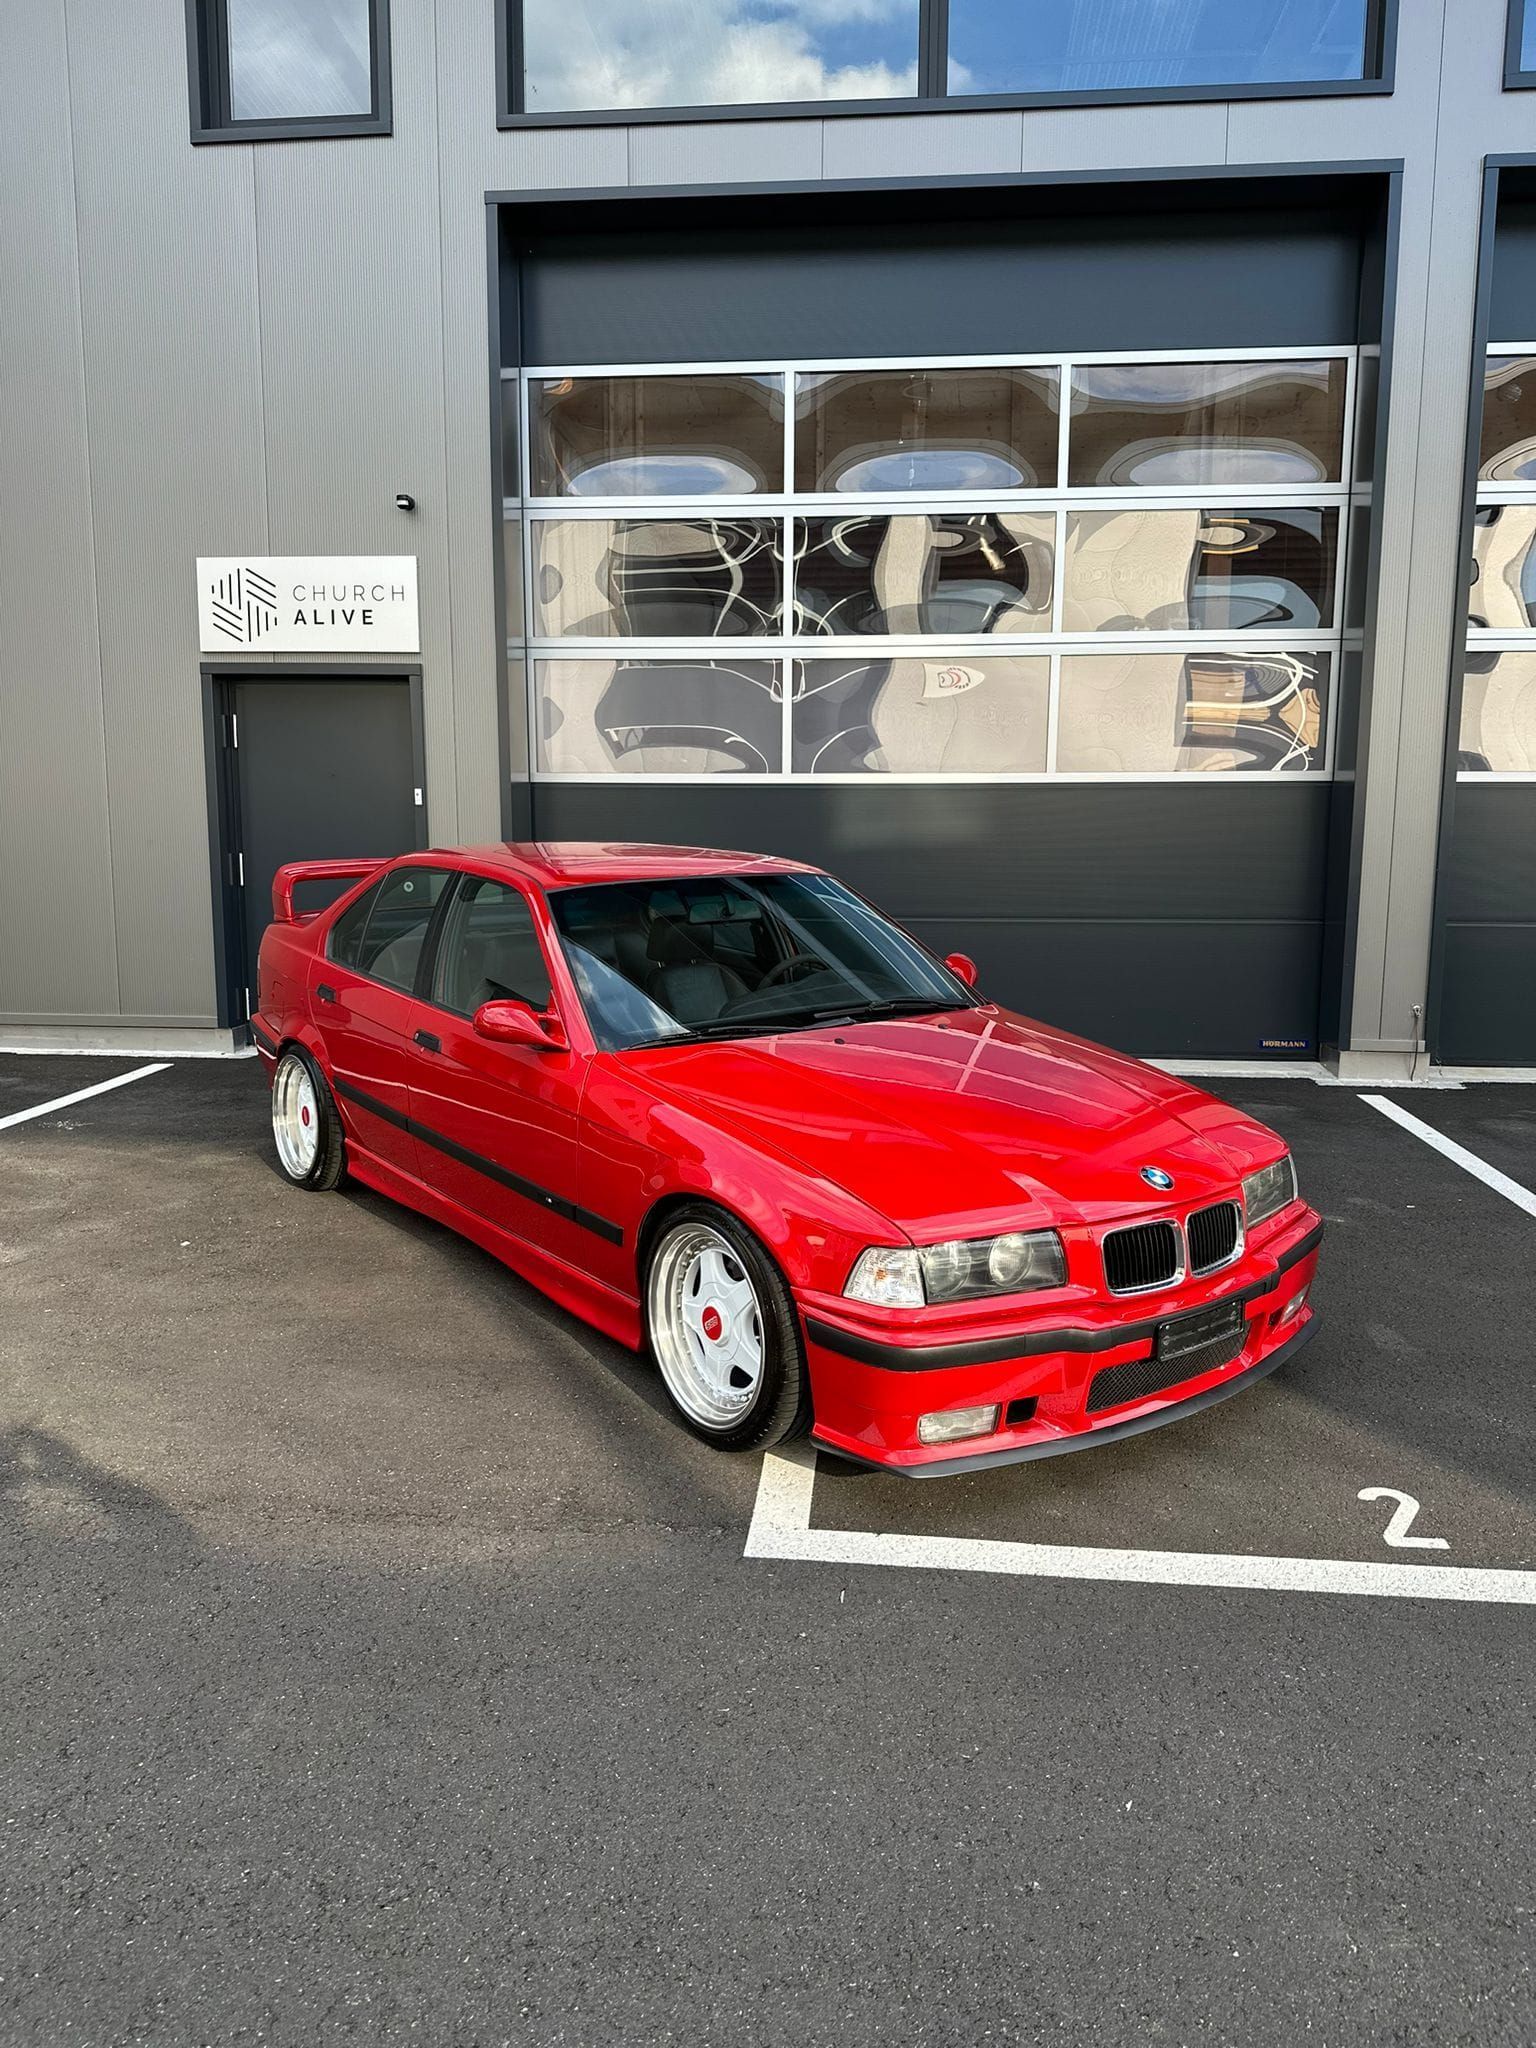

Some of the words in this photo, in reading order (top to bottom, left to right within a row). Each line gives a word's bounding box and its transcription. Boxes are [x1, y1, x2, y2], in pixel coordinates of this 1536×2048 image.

[292, 585, 405, 602] CHURCH
[294, 609, 373, 625] ALIVE
[1357, 1487, 1450, 1550] 2
